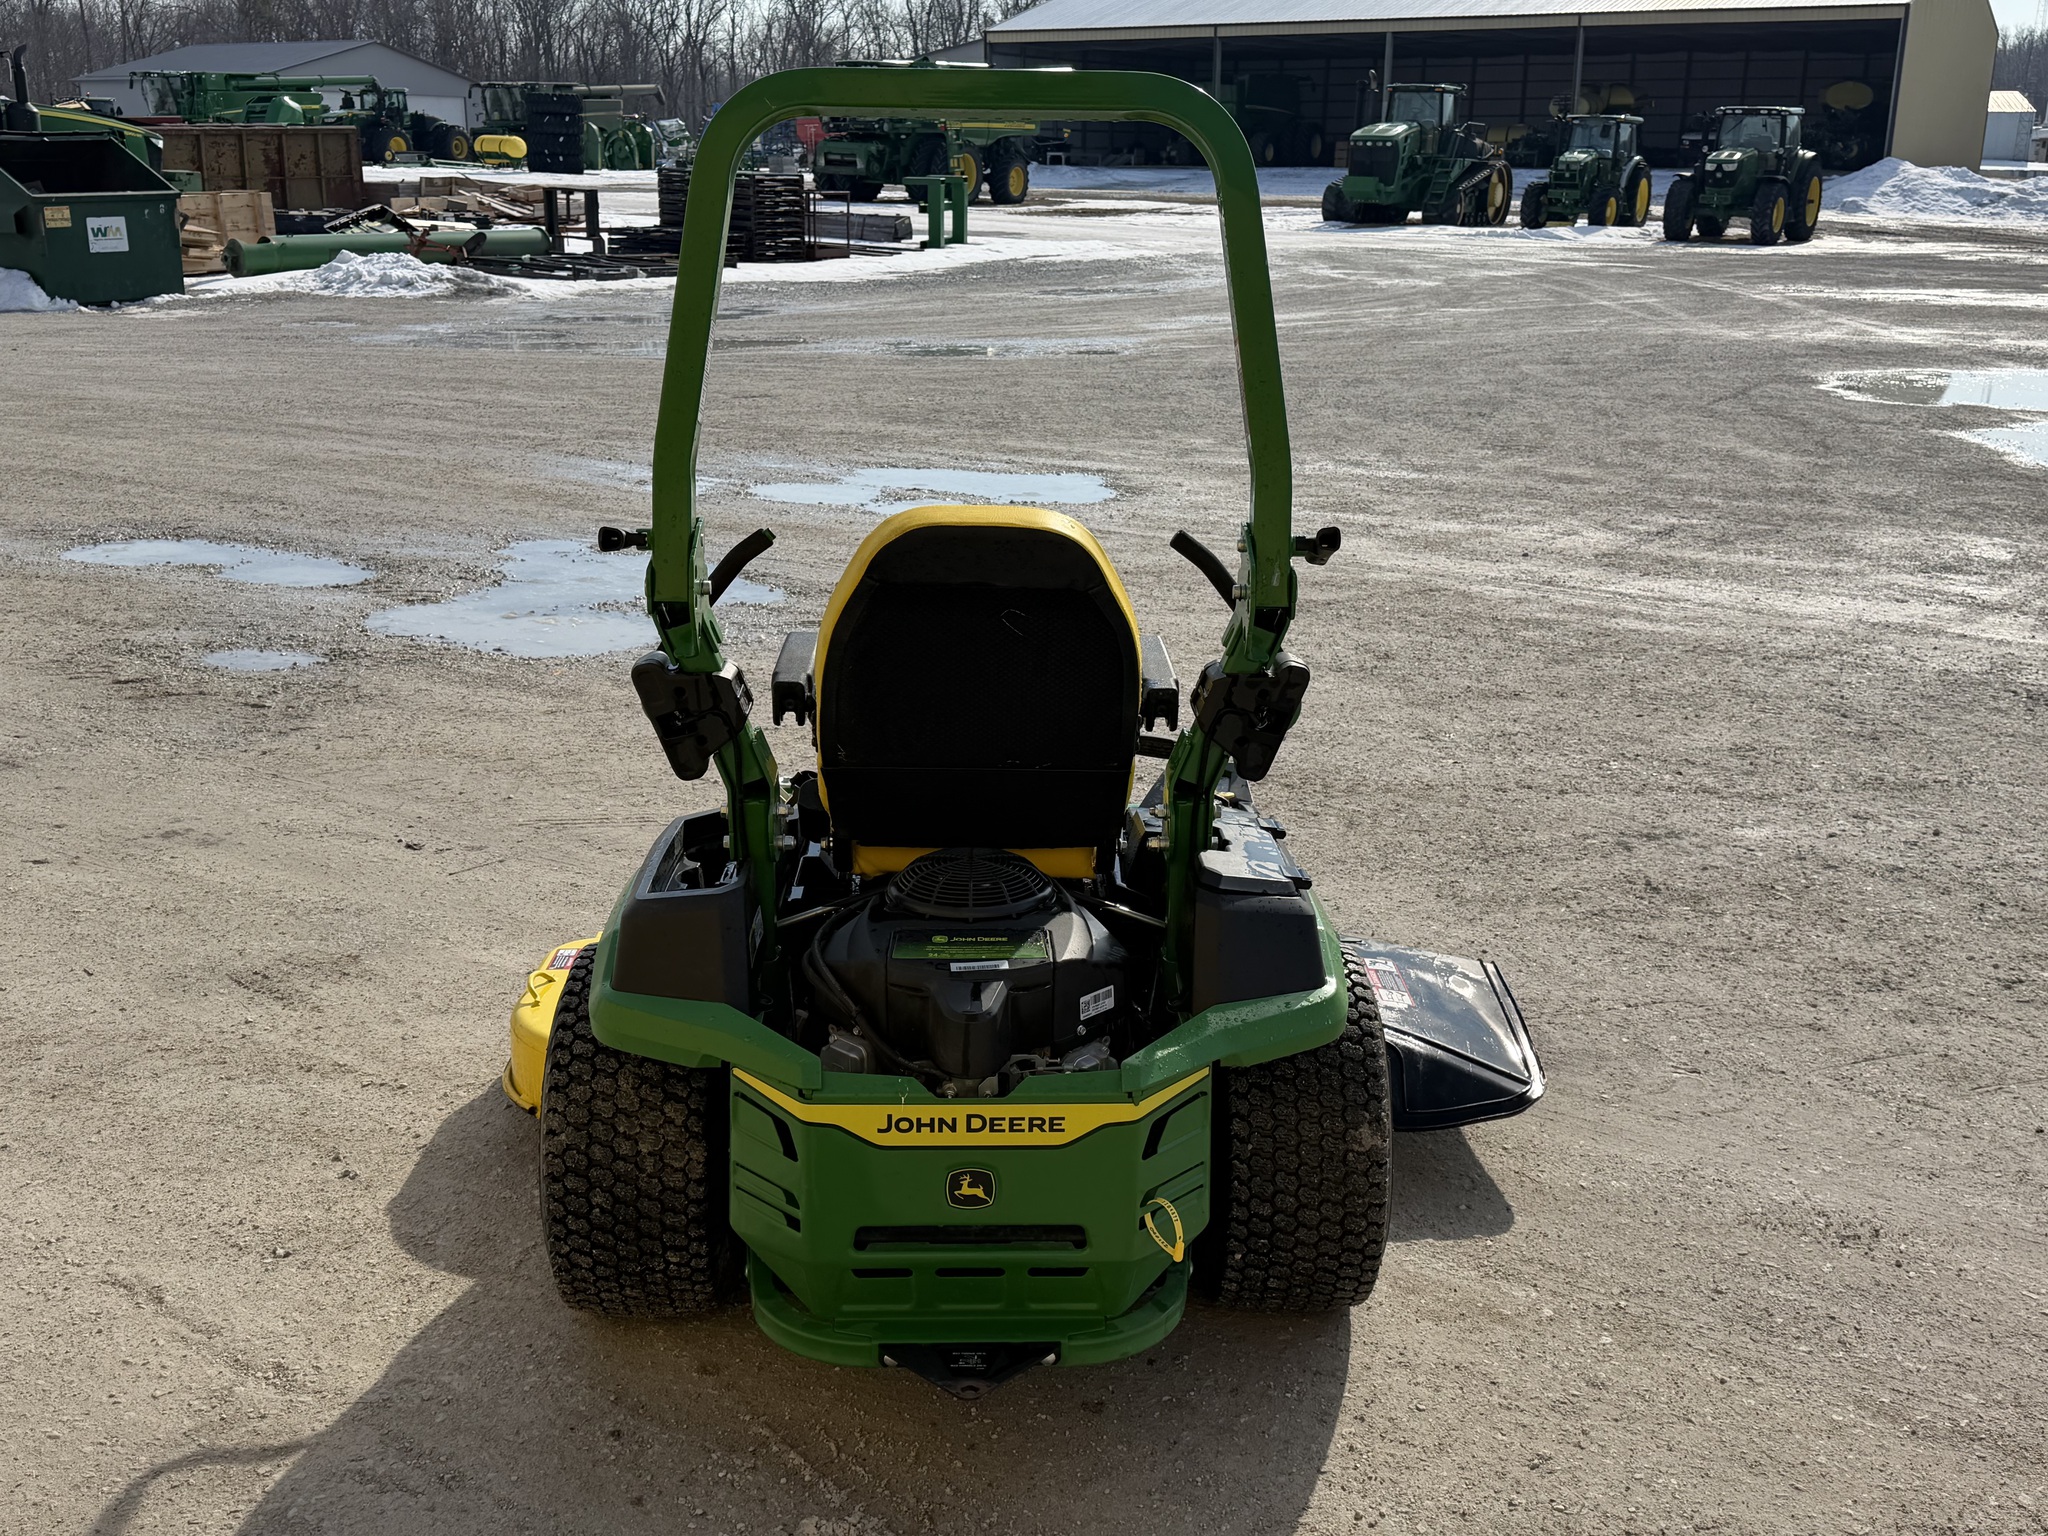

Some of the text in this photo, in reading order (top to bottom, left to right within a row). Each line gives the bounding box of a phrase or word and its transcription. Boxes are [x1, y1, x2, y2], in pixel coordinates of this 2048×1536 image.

[90, 225, 123, 238] WM
[877, 1114, 1066, 1133] JOHN DEERE
